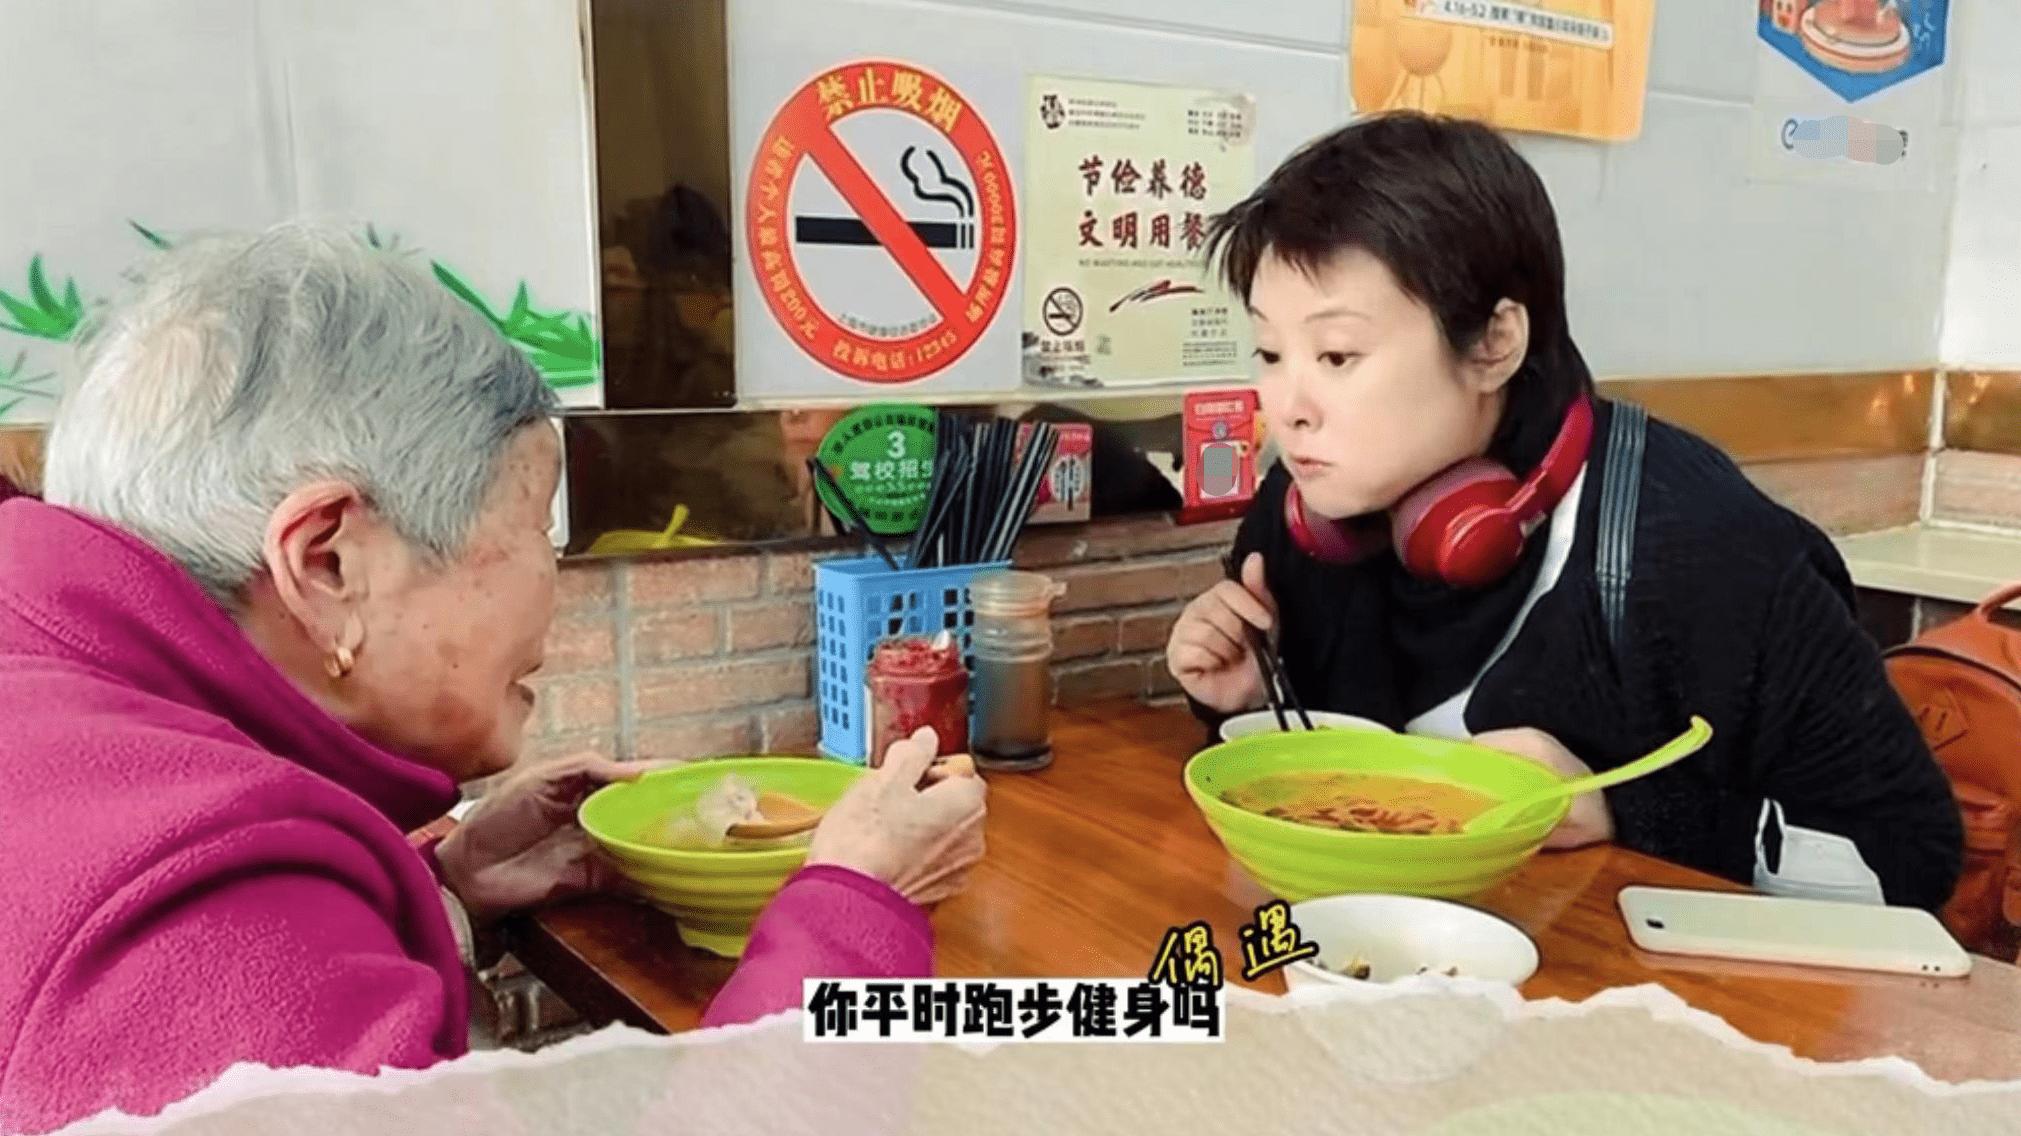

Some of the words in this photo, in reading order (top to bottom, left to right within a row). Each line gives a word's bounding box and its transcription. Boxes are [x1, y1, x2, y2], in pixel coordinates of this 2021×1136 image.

[816, 68, 962, 132] 禁止吸烟
[1078, 154, 1208, 200] 节俭养德
[1078, 209, 1206, 250] 文明用餐
[887, 430, 906, 459] 3
